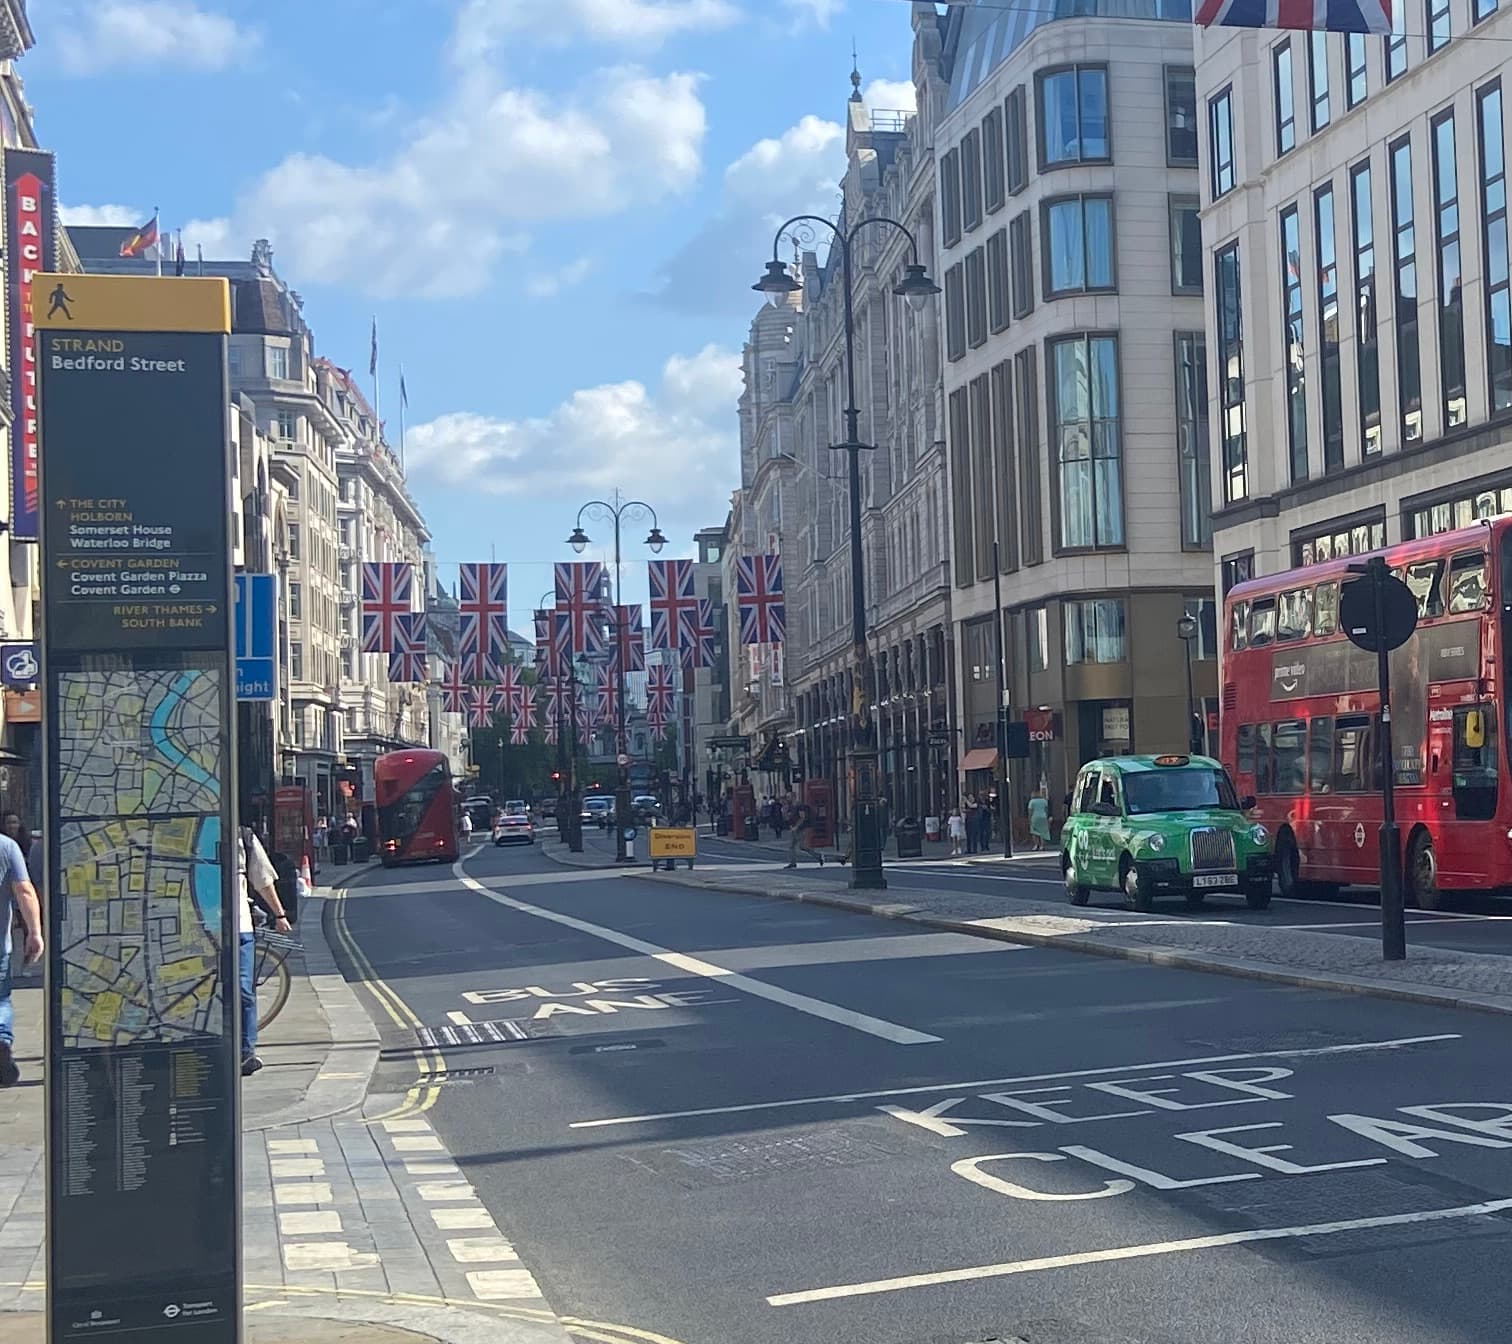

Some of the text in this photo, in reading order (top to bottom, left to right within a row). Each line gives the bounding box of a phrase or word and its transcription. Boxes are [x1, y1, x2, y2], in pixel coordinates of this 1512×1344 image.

[52, 339, 124, 352] STRAND
[52, 355, 186, 372] Bedford Street
[70, 499, 127, 508] THE CITY
[71, 512, 133, 522] HOLBORN
[69, 525, 172, 535] Somerset House
[70, 538, 171, 549] Waterloo Bridge
[71, 559, 179, 569] COVENT GARDEN
[71, 571, 207, 582] Covent Garden Piazza
[71, 585, 165, 595] Covent Garden
[114, 605, 202, 615] RIVER THAMES
[122, 618, 202, 628] SOUTH BANK
[1029, 730, 1053, 741] EON
[461, 978, 662, 1004] BUS
[446, 989, 741, 1026] LANE
[874, 1066, 1297, 1137] KEEP
